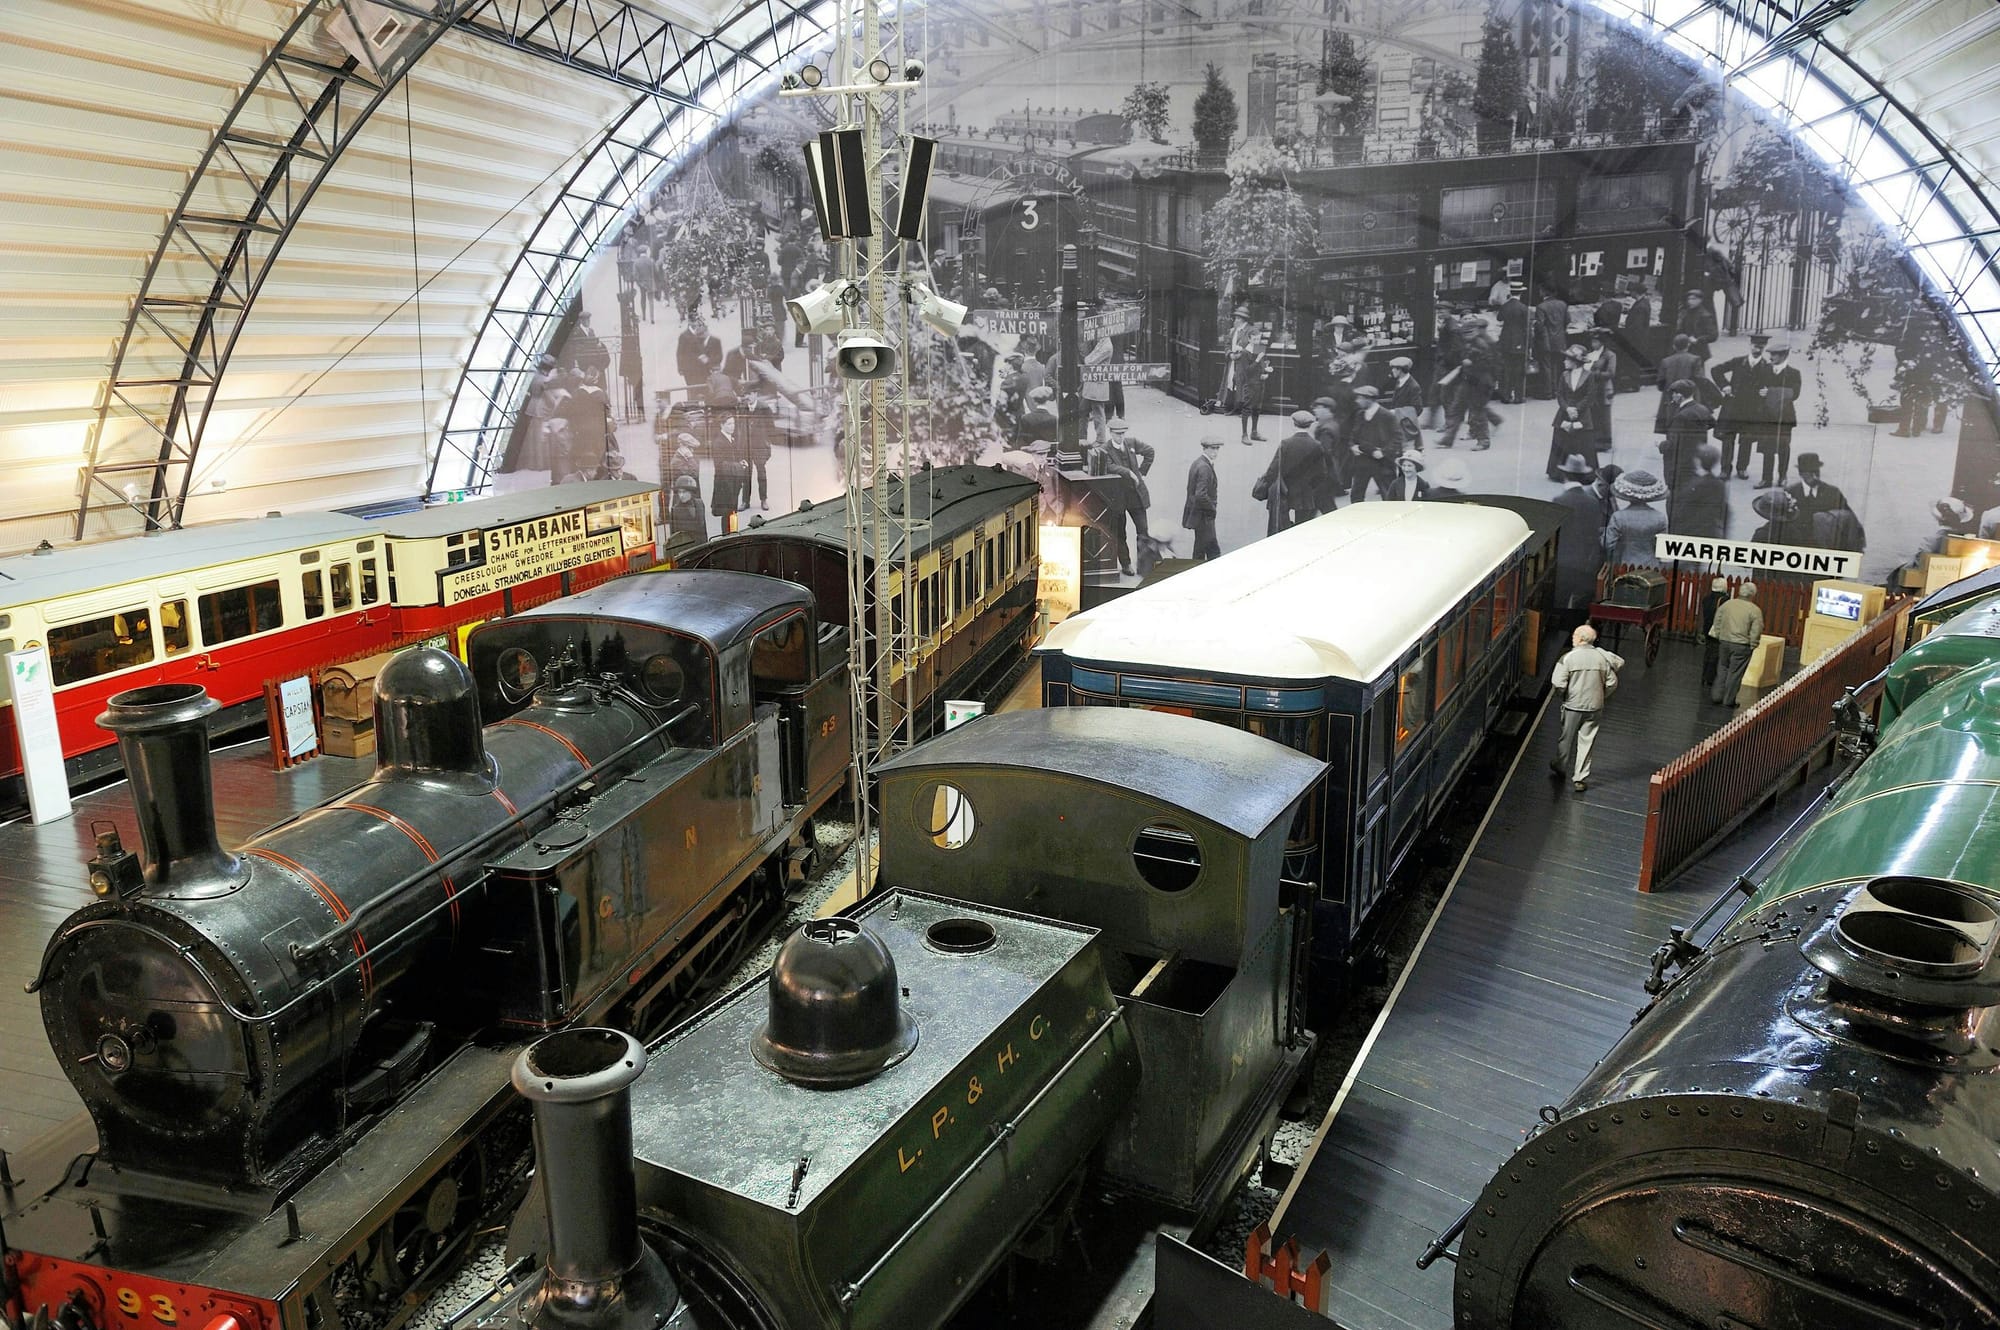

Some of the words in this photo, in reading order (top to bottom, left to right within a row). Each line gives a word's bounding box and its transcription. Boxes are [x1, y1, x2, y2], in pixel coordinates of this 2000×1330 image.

[1020, 200, 1039, 230] 3
[989, 319, 1048, 335] BANGOR
[995, 311, 1019, 320] TRAIN
[1023, 311, 1040, 320] FOR
[1083, 317, 1099, 330] RAIL
[1083, 330, 1096, 342] FOR
[1082, 372, 1147, 382] CASTLEWELLAN
[1089, 365, 1118, 373] TRAIN
[1122, 365, 1143, 373] FOR
[490, 513, 580, 551] STRABANE
[455, 563, 507, 585] CREESLOUGH
[516, 550, 554, 568] GWEEDORE
[573, 535, 614, 553] BURTONPORT
[490, 550, 519, 564] CHANGE
[524, 546, 534, 555] FOR
[538, 533, 584, 552] LETTERKENNY
[1665, 540, 1849, 574] WARRENPOINT
[453, 585, 491, 602] DONEGAL
[494, 566, 543, 589] STRANORLAR
[546, 555, 582, 573] KILLYBEGS
[584, 546, 616, 563] GLENTIES
[684, 825, 698, 850] N
[897, 1146, 923, 1173] L.
[931, 1105, 955, 1140] P.
[967, 1075, 984, 1105] &
[997, 1042, 1020, 1074] H.
[1029, 1014, 1051, 1040] C.
[116, 1287, 177, 1327] 93
